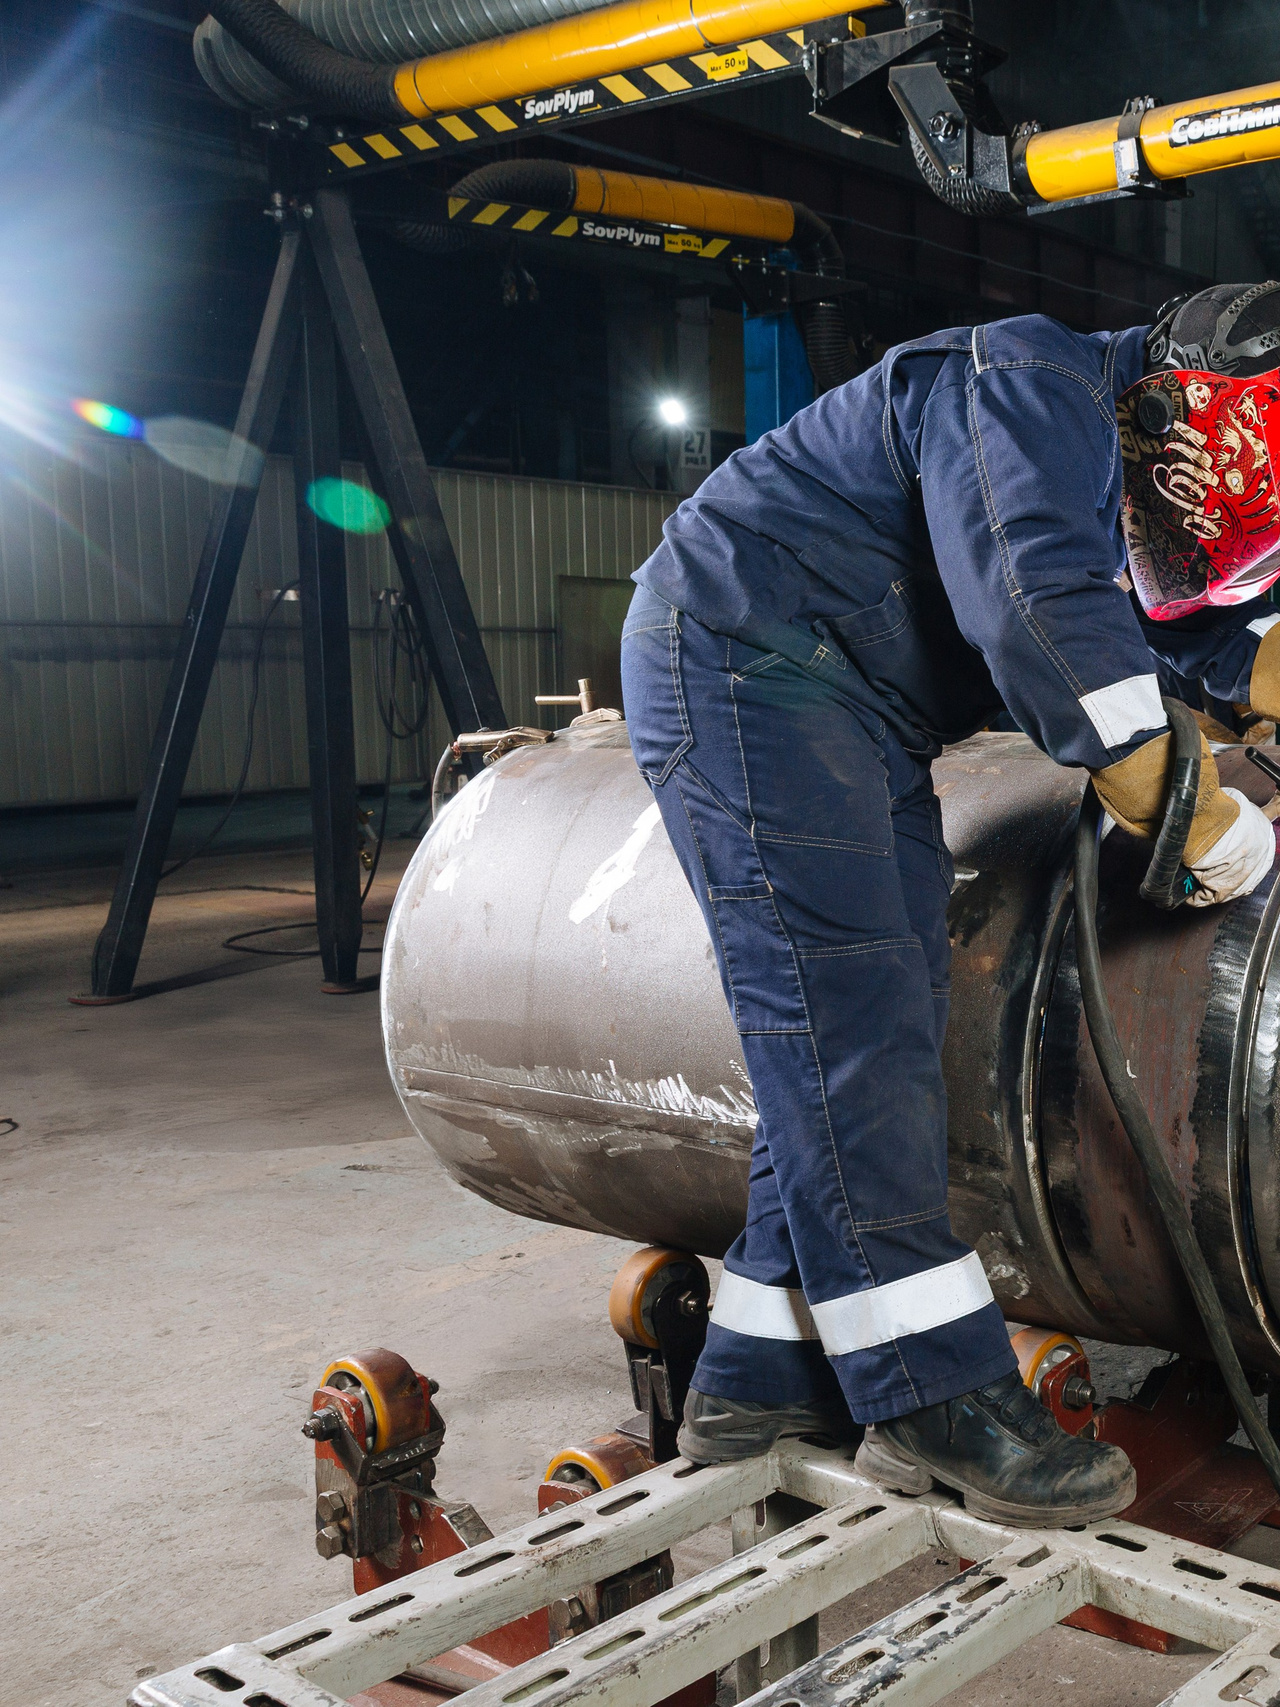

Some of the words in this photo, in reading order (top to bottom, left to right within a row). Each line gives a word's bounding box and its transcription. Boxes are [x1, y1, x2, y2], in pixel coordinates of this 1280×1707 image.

[724, 58, 736, 69] 50
[524, 89, 595, 120] SovPlym
[582, 221, 661, 247] SovPlym
[681, 239, 692, 247] 50
[684, 430, 706, 454] 27
